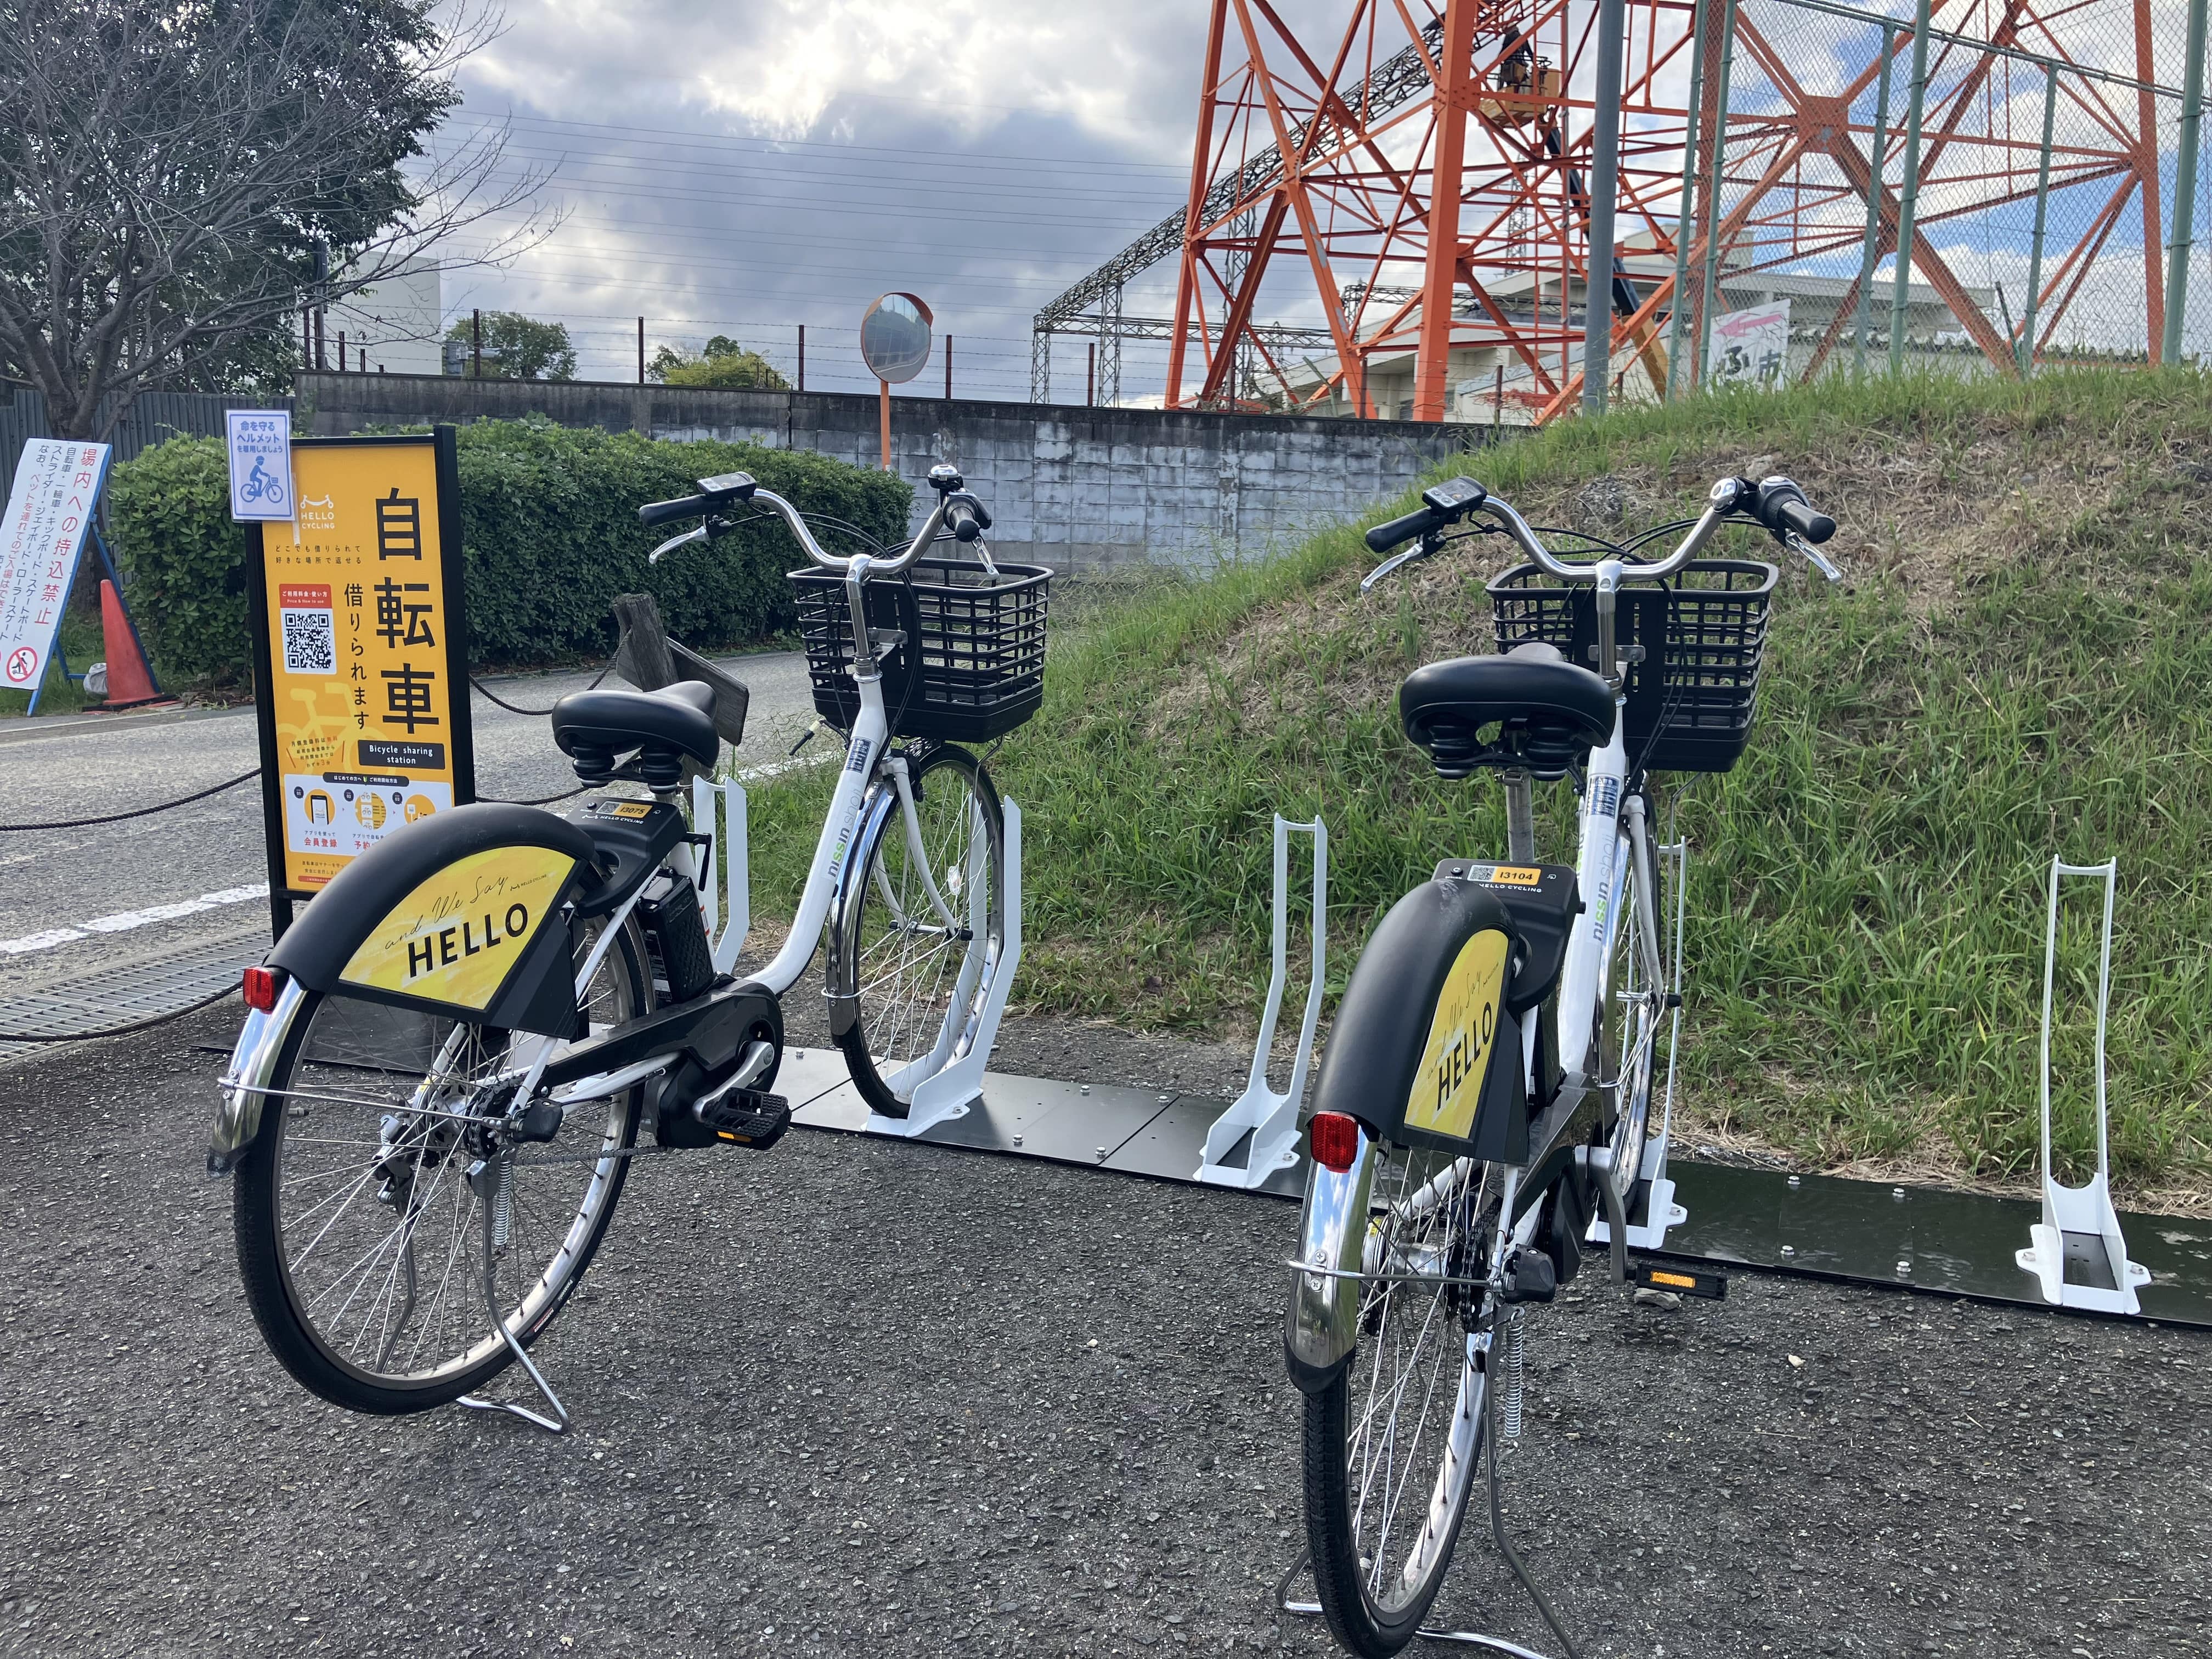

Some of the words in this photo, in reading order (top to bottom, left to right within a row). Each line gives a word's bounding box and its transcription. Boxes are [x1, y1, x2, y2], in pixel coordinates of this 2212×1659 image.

[236, 433, 280, 443] ヘルメット
[237, 445, 283, 453] を着用しましょう
[240, 421, 275, 431] 命を守る
[13, 447, 76, 642] 自転車・一輪車・キックボード・スケートボード
[34, 448, 97, 624] 場内への持込禁止
[275, 544, 360, 552] どこでも借りられて
[374, 487, 439, 734] 自転車
[344, 583, 369, 730] 借りられます
[369, 744, 398, 754] Bicycle
[403, 746, 433, 757] sharing
[387, 756, 416, 764] station
[304, 837, 337, 848] 会員登録
[354, 840, 374, 851] 予約
[828, 827, 850, 877] nissin
[385, 915, 424, 950] and
[432, 891, 463, 923] We
[470, 876, 509, 904] Say
[1593, 882, 1609, 941] nissin
[408, 903, 528, 978] HELLO
[1437, 1001, 1492, 1111] HELLO
